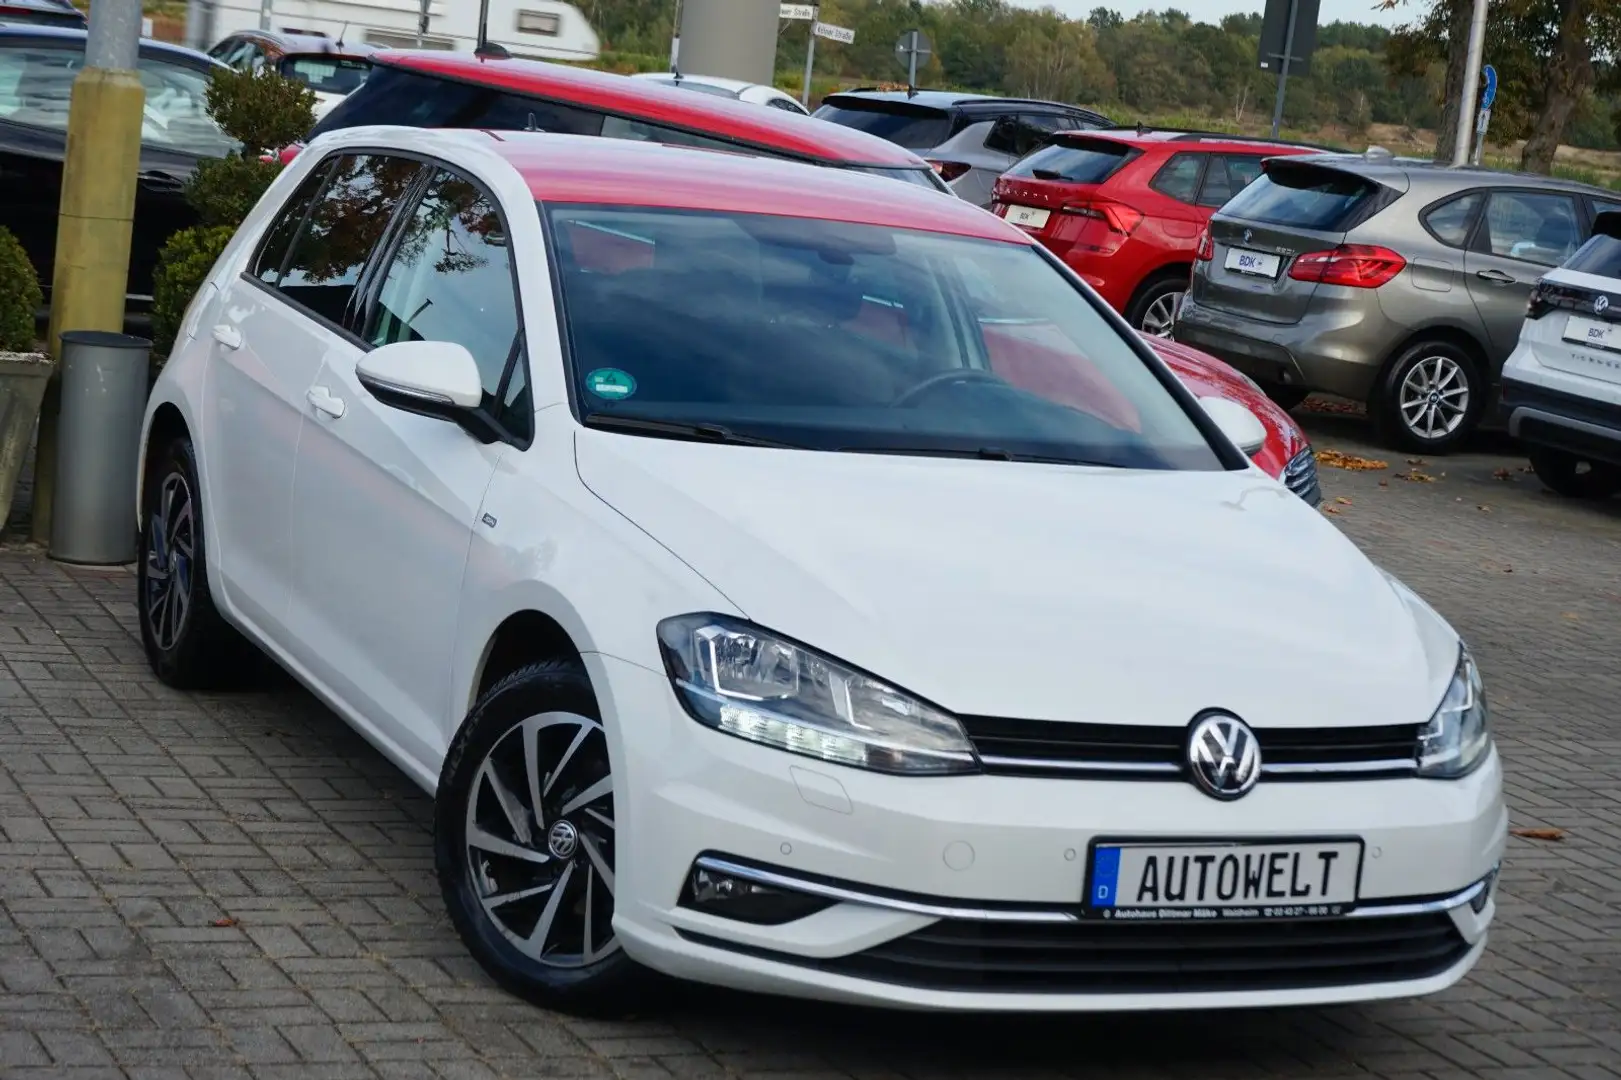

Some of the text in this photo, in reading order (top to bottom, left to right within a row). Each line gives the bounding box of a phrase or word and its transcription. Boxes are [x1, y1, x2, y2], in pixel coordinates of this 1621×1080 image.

[1239, 255, 1256, 267] BDK
[1588, 328, 1604, 339] BDK
[1136, 851, 1339, 902] AUTOWELT
[1098, 885, 1108, 899] D
[1115, 908, 1157, 918] Autohaus
